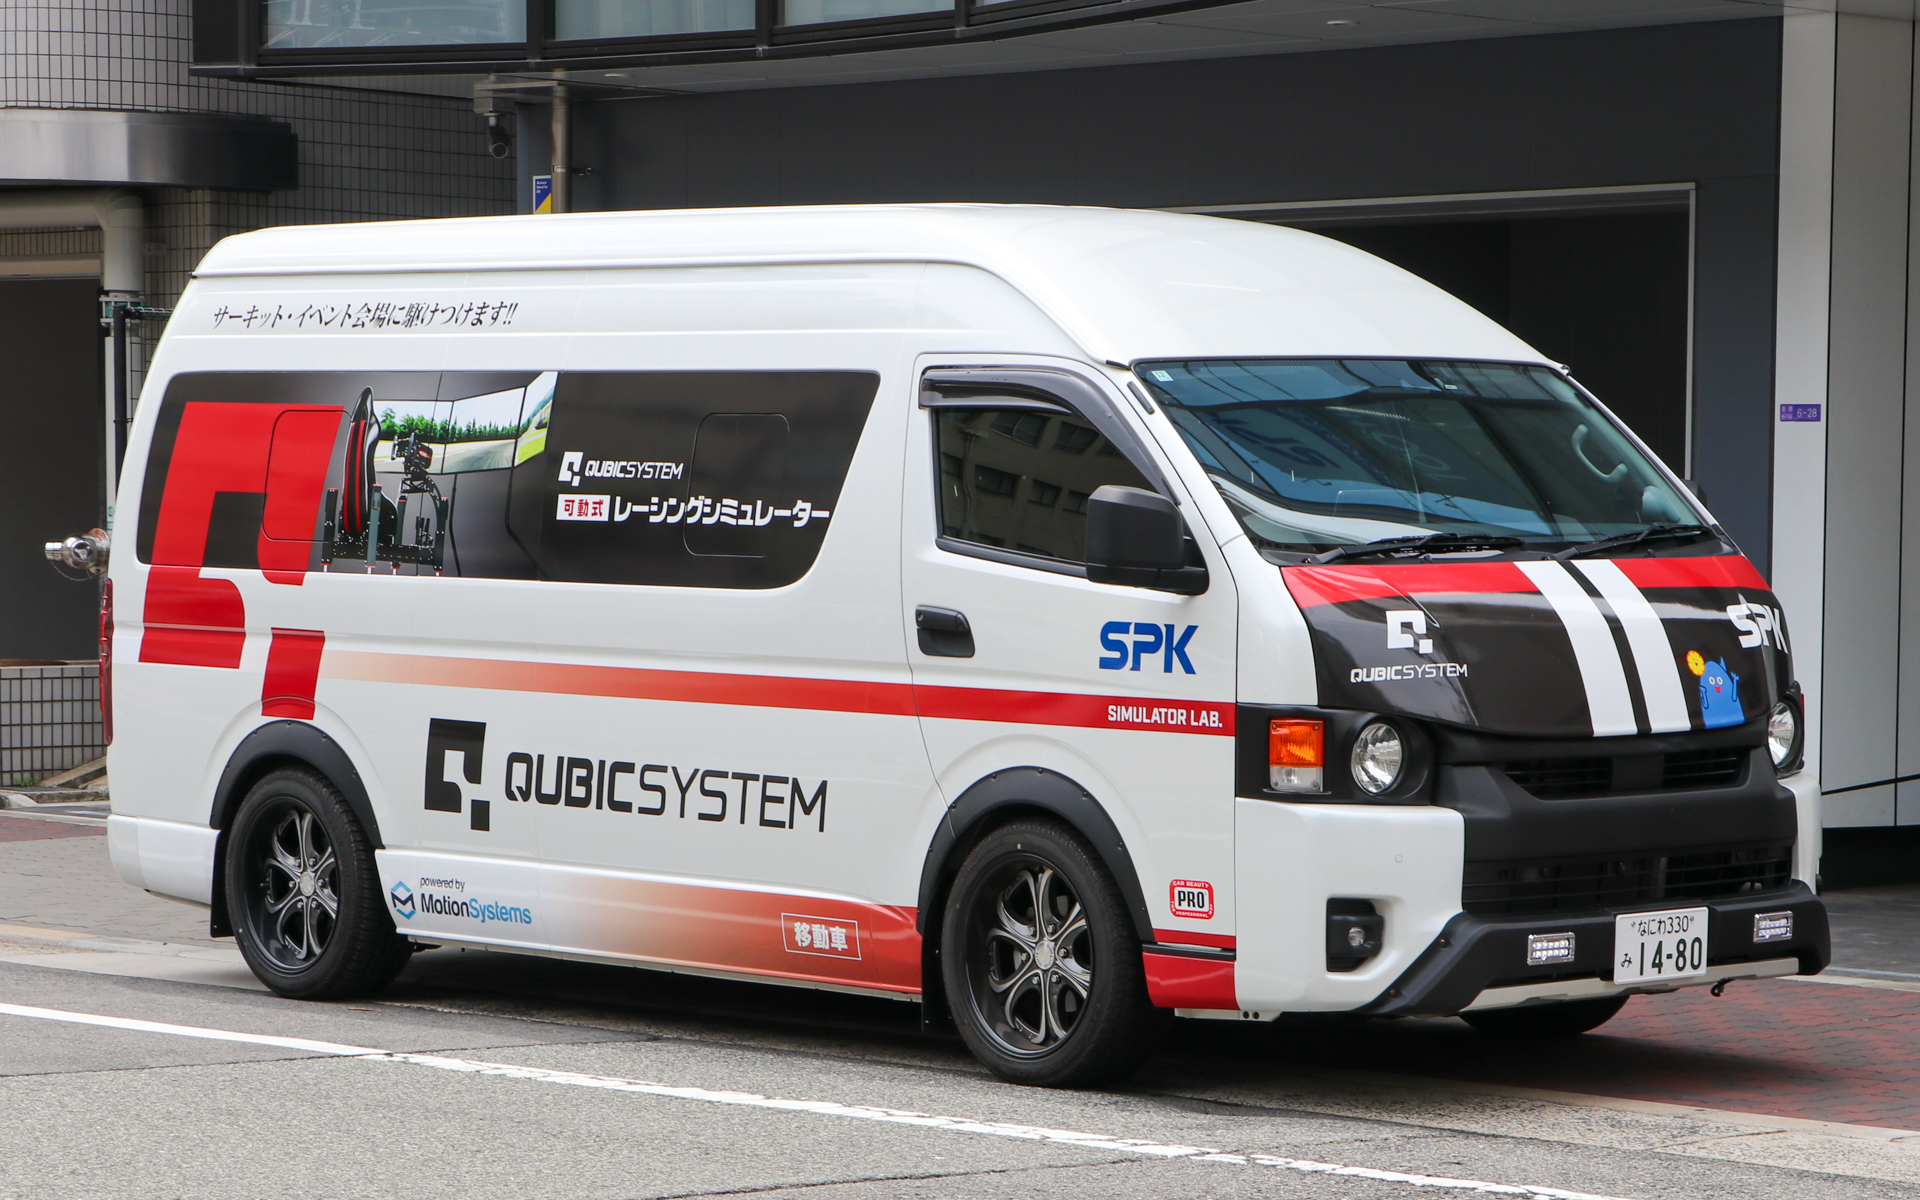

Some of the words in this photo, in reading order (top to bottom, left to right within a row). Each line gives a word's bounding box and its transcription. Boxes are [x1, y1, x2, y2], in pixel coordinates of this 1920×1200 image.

[1796, 408, 1818, 418] 6-28
[584, 459, 684, 480] QUBICSYSTEM
[564, 499, 604, 518] 可動式
[613, 495, 830, 528] レーシングシミュレーター
[1726, 603, 1789, 655] SPK
[1099, 621, 1199, 675] SPK
[1350, 662, 1468, 685] QUBICSYSTEM
[1107, 704, 1187, 726] SIMULATOR
[1190, 709, 1223, 728] LAB.
[504, 751, 828, 833] QUBICSYSTEM
[420, 877, 454, 889] powered
[455, 879, 466, 893] by
[1177, 890, 1205, 909] PRO
[420, 892, 532, 924] MotionSystems
[793, 921, 849, 952] 移動車
[1620, 952, 1633, 968] み
[1639, 936, 1702, 976] 14-80
